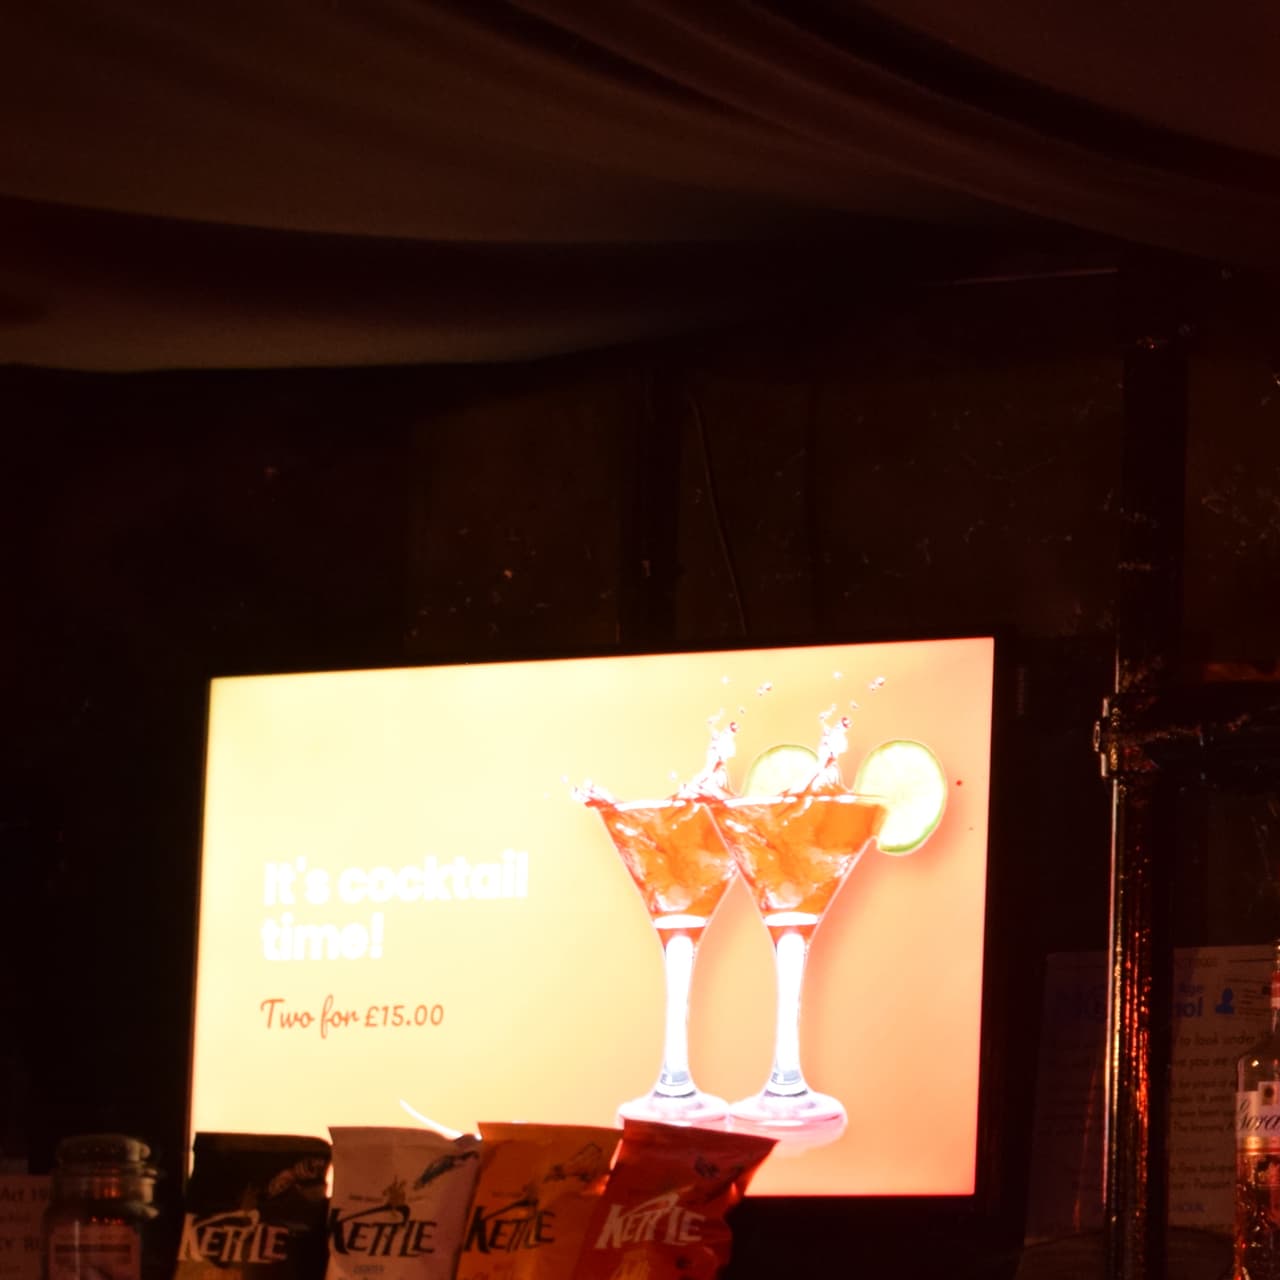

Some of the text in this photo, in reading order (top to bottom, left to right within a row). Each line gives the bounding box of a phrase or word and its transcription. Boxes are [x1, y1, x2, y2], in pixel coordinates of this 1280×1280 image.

[263, 848, 529, 906] It's cocktail
[259, 911, 385, 961] time!
[260, 993, 445, 1040] Two for £15.00
[177, 1207, 290, 1265] KETTLE
[327, 1203, 439, 1258] KETTLE
[594, 1190, 707, 1251] KETTLE
